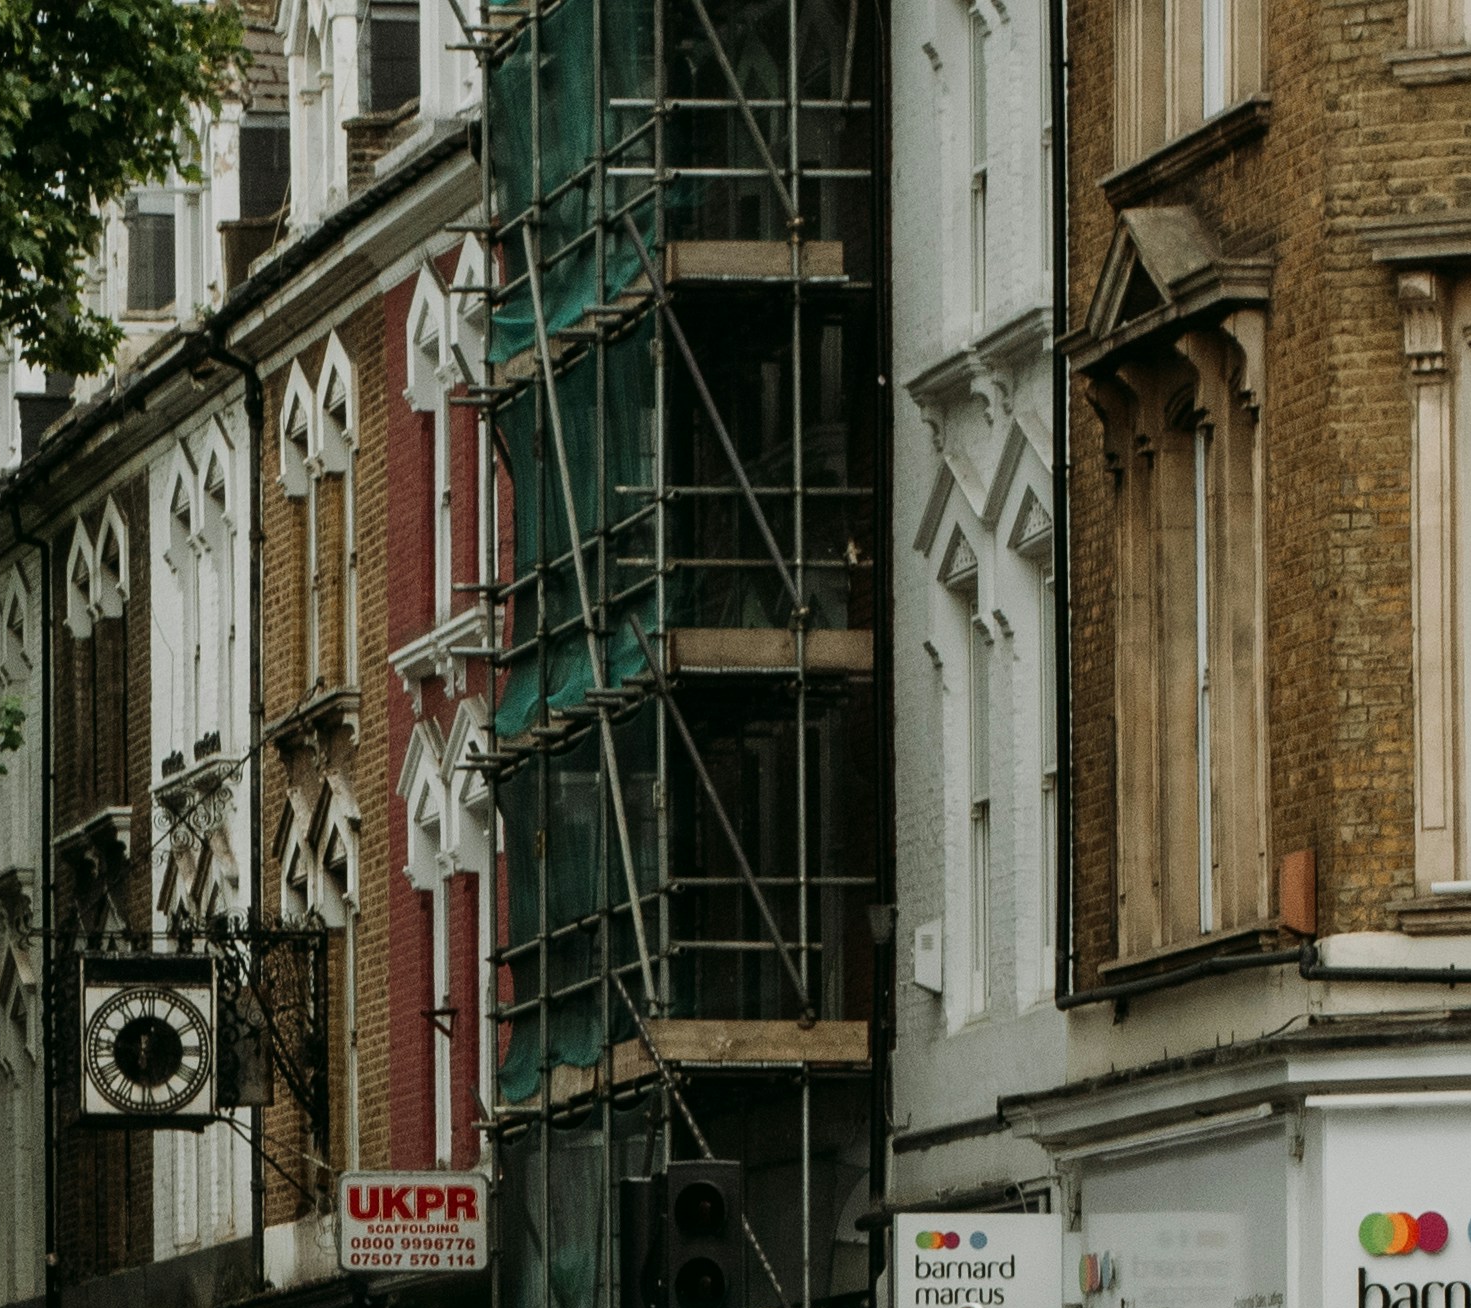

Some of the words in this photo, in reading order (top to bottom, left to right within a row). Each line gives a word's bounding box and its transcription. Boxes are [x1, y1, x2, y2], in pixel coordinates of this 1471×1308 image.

[347, 1184, 479, 1222] UKPR
[367, 1224, 460, 1235] SCAFFOLDING
[351, 1237, 394, 1250] 0800
[400, 1237, 475, 1250] 9996776
[351, 1253, 402, 1266] 07507
[410, 1253, 440, 1266] 570
[447, 1254, 475, 1266] 114
[915, 1254, 1016, 1280] barnard
[915, 1287, 1005, 1306] marcus
